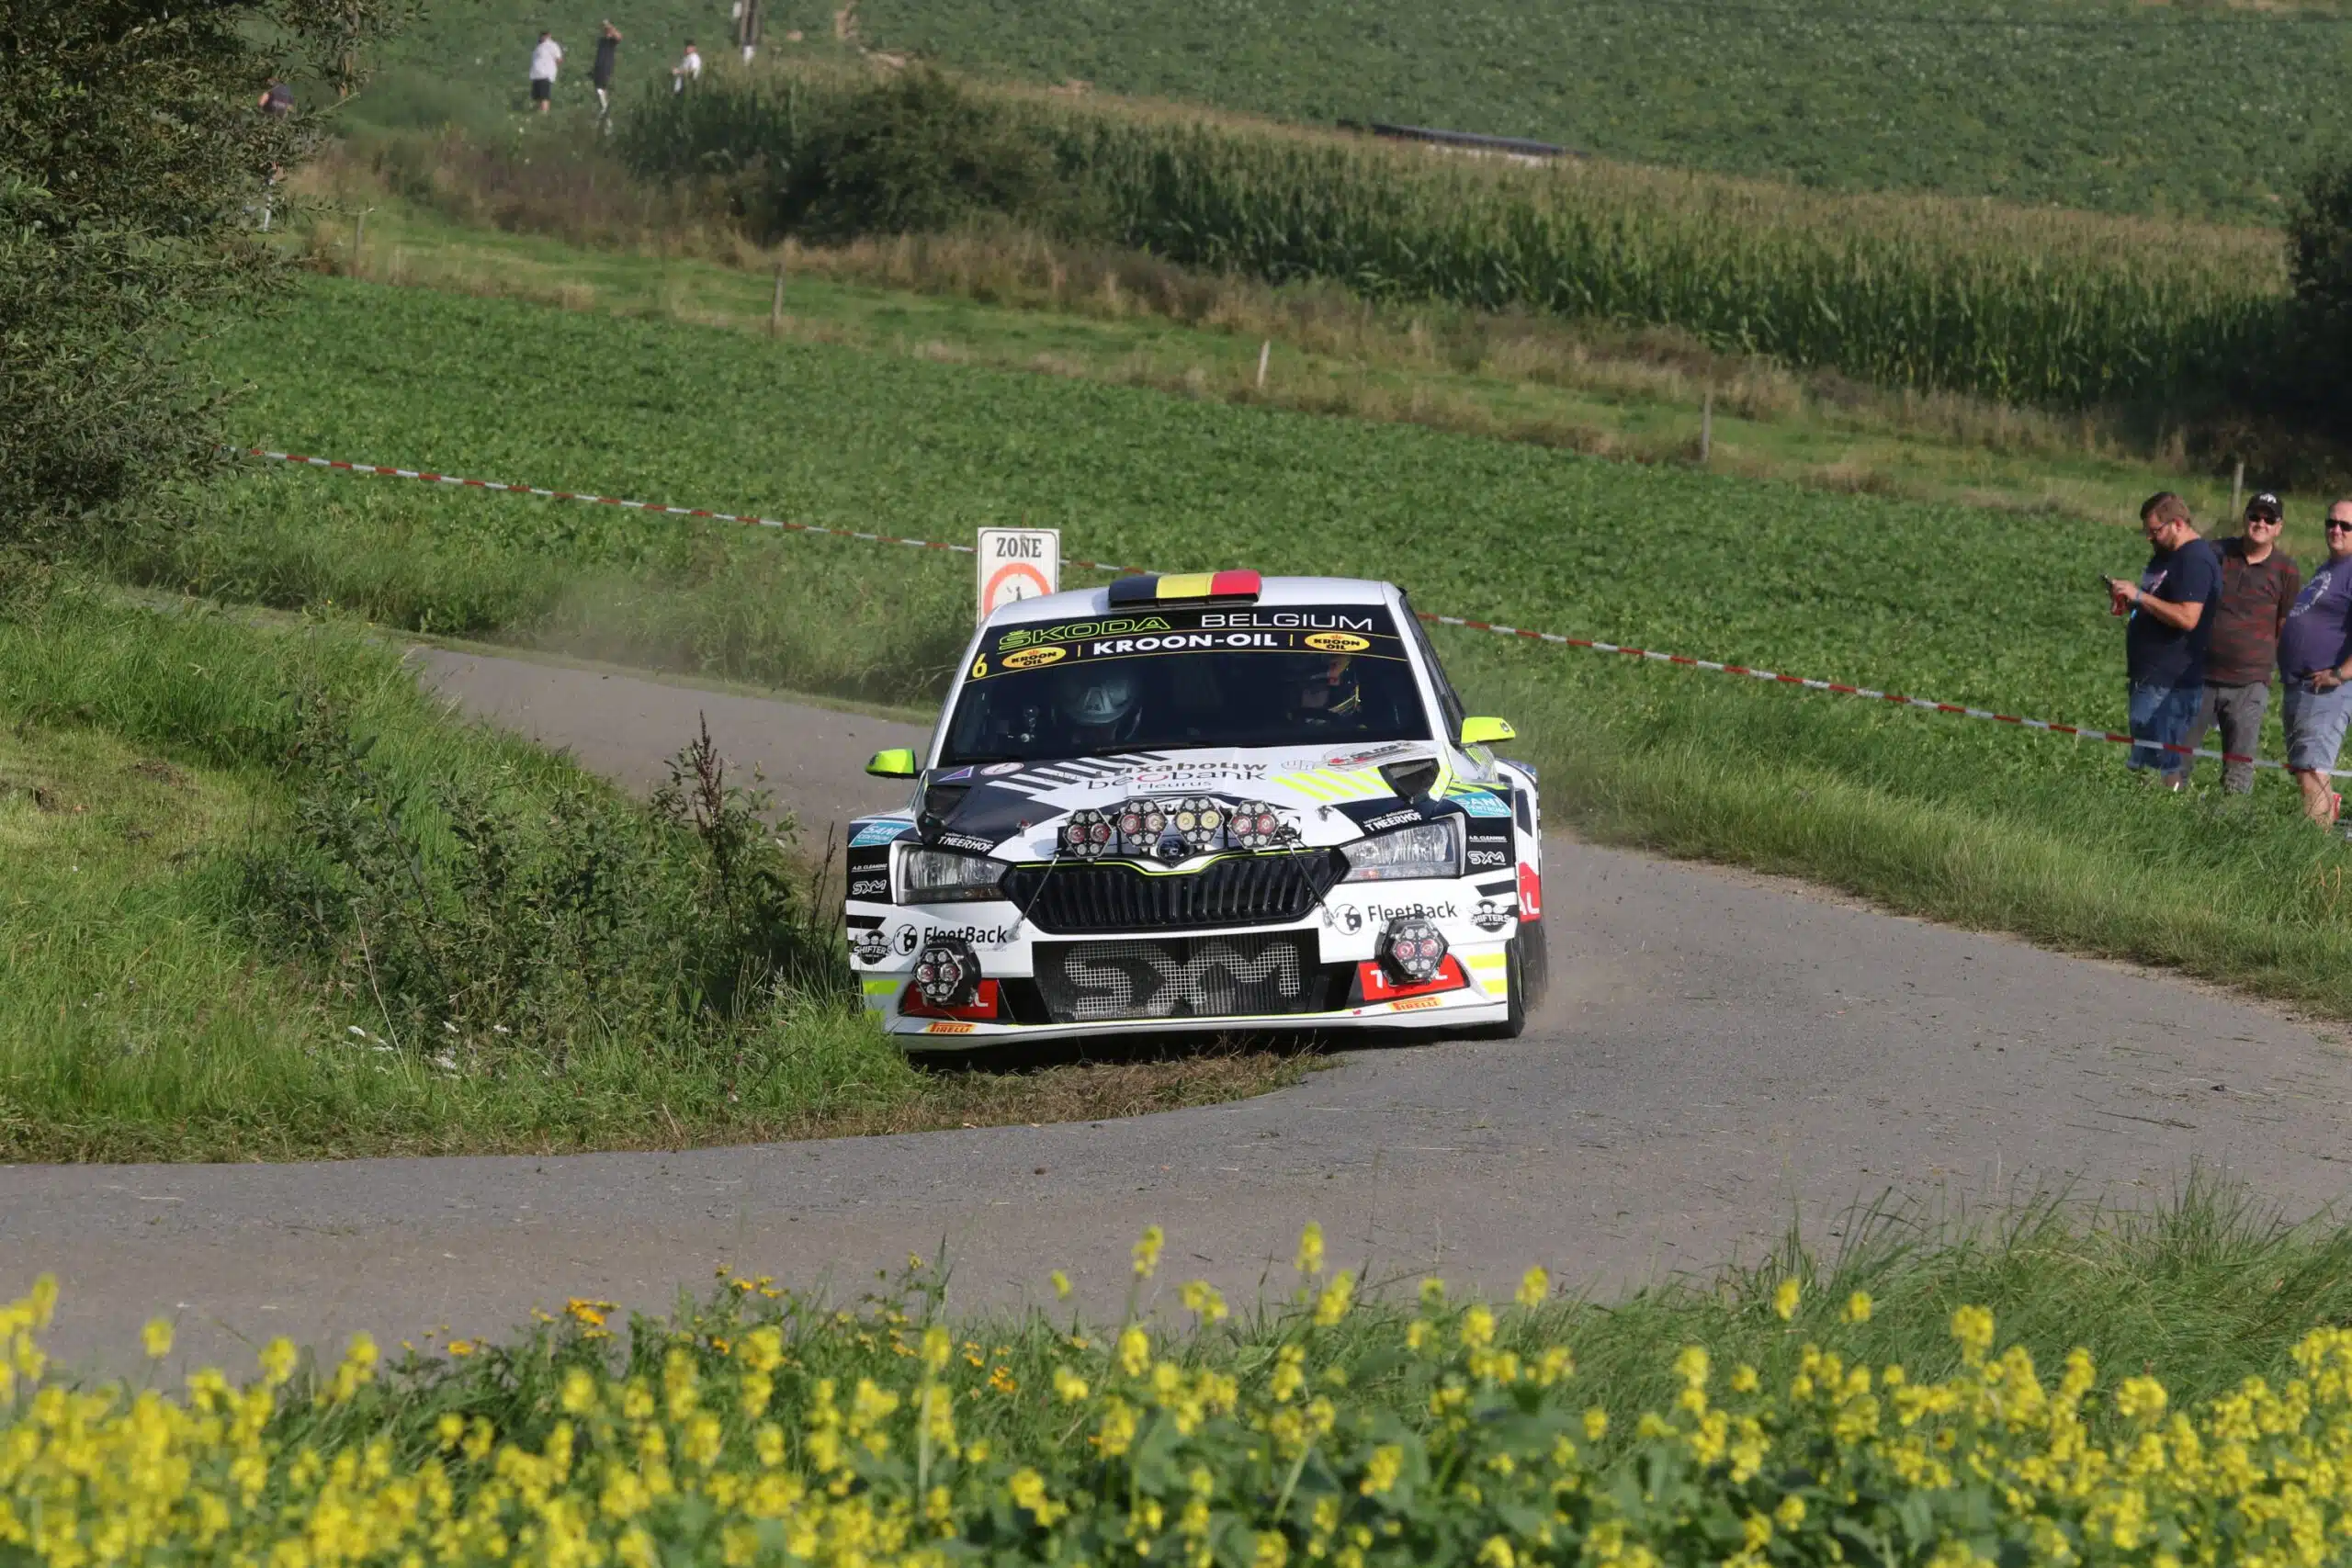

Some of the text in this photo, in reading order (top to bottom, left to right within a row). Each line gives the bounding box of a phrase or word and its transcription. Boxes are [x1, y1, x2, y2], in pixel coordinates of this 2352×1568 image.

[996, 537, 1042, 558] ZONE
[1201, 613, 1372, 631] BELGIUM
[1093, 634, 1278, 655] KROON-OIL
[1314, 638, 1360, 647] KROON
[1011, 651, 1057, 663] KROON
[972, 653, 988, 678] 6
[1467, 851, 1506, 864] SXM
[852, 879, 888, 896] SXM
[1470, 913, 1511, 925] SHIFTERS
[854, 945, 893, 956] SHIFTERS
[1065, 941, 1301, 1019] SXM
[1392, 998, 1440, 1011] PIRELLI
[929, 1022, 975, 1033] PIRELLI
